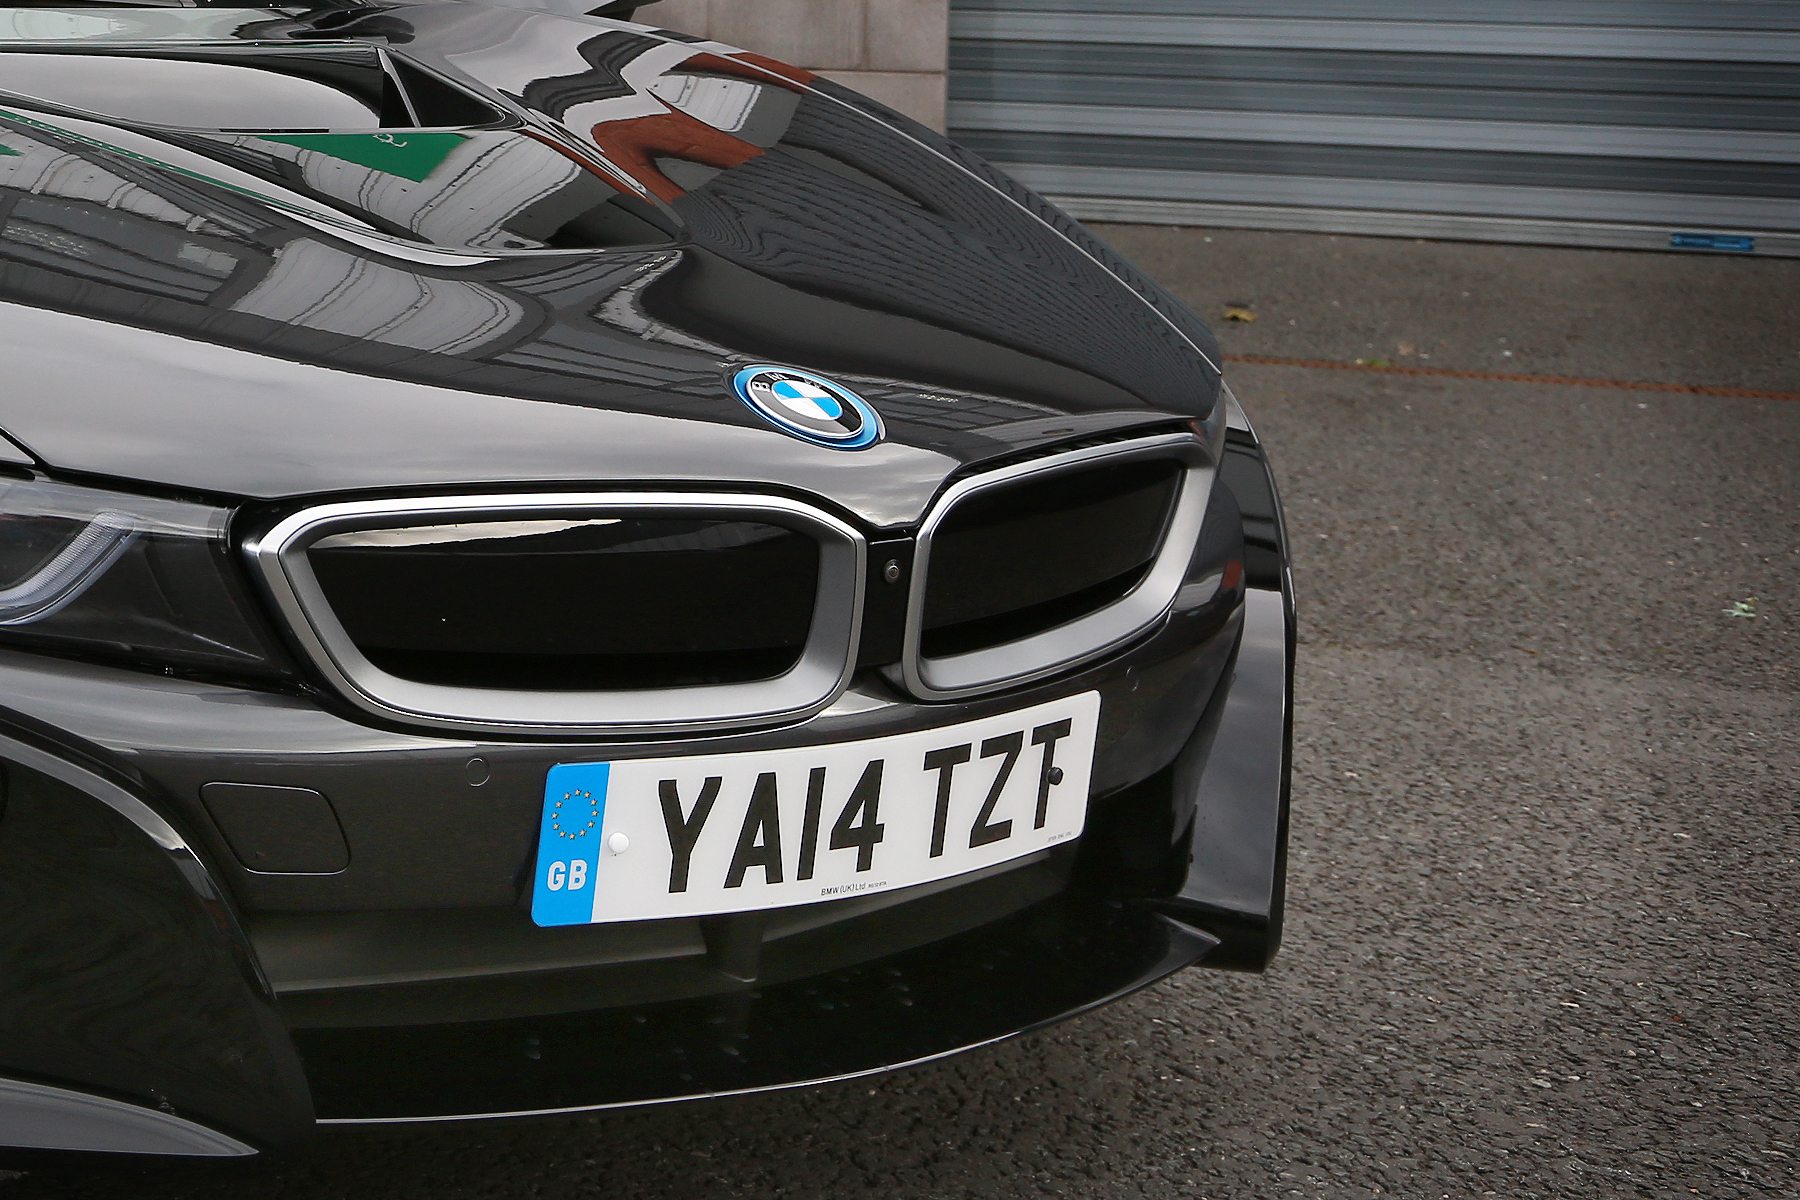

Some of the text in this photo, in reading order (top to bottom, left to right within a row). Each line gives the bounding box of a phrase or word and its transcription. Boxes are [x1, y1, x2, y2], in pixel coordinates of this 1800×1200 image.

[658, 718, 1072, 893] YA14 TZT
[546, 859, 589, 892] GB
[820, 886, 840, 896] BMW
